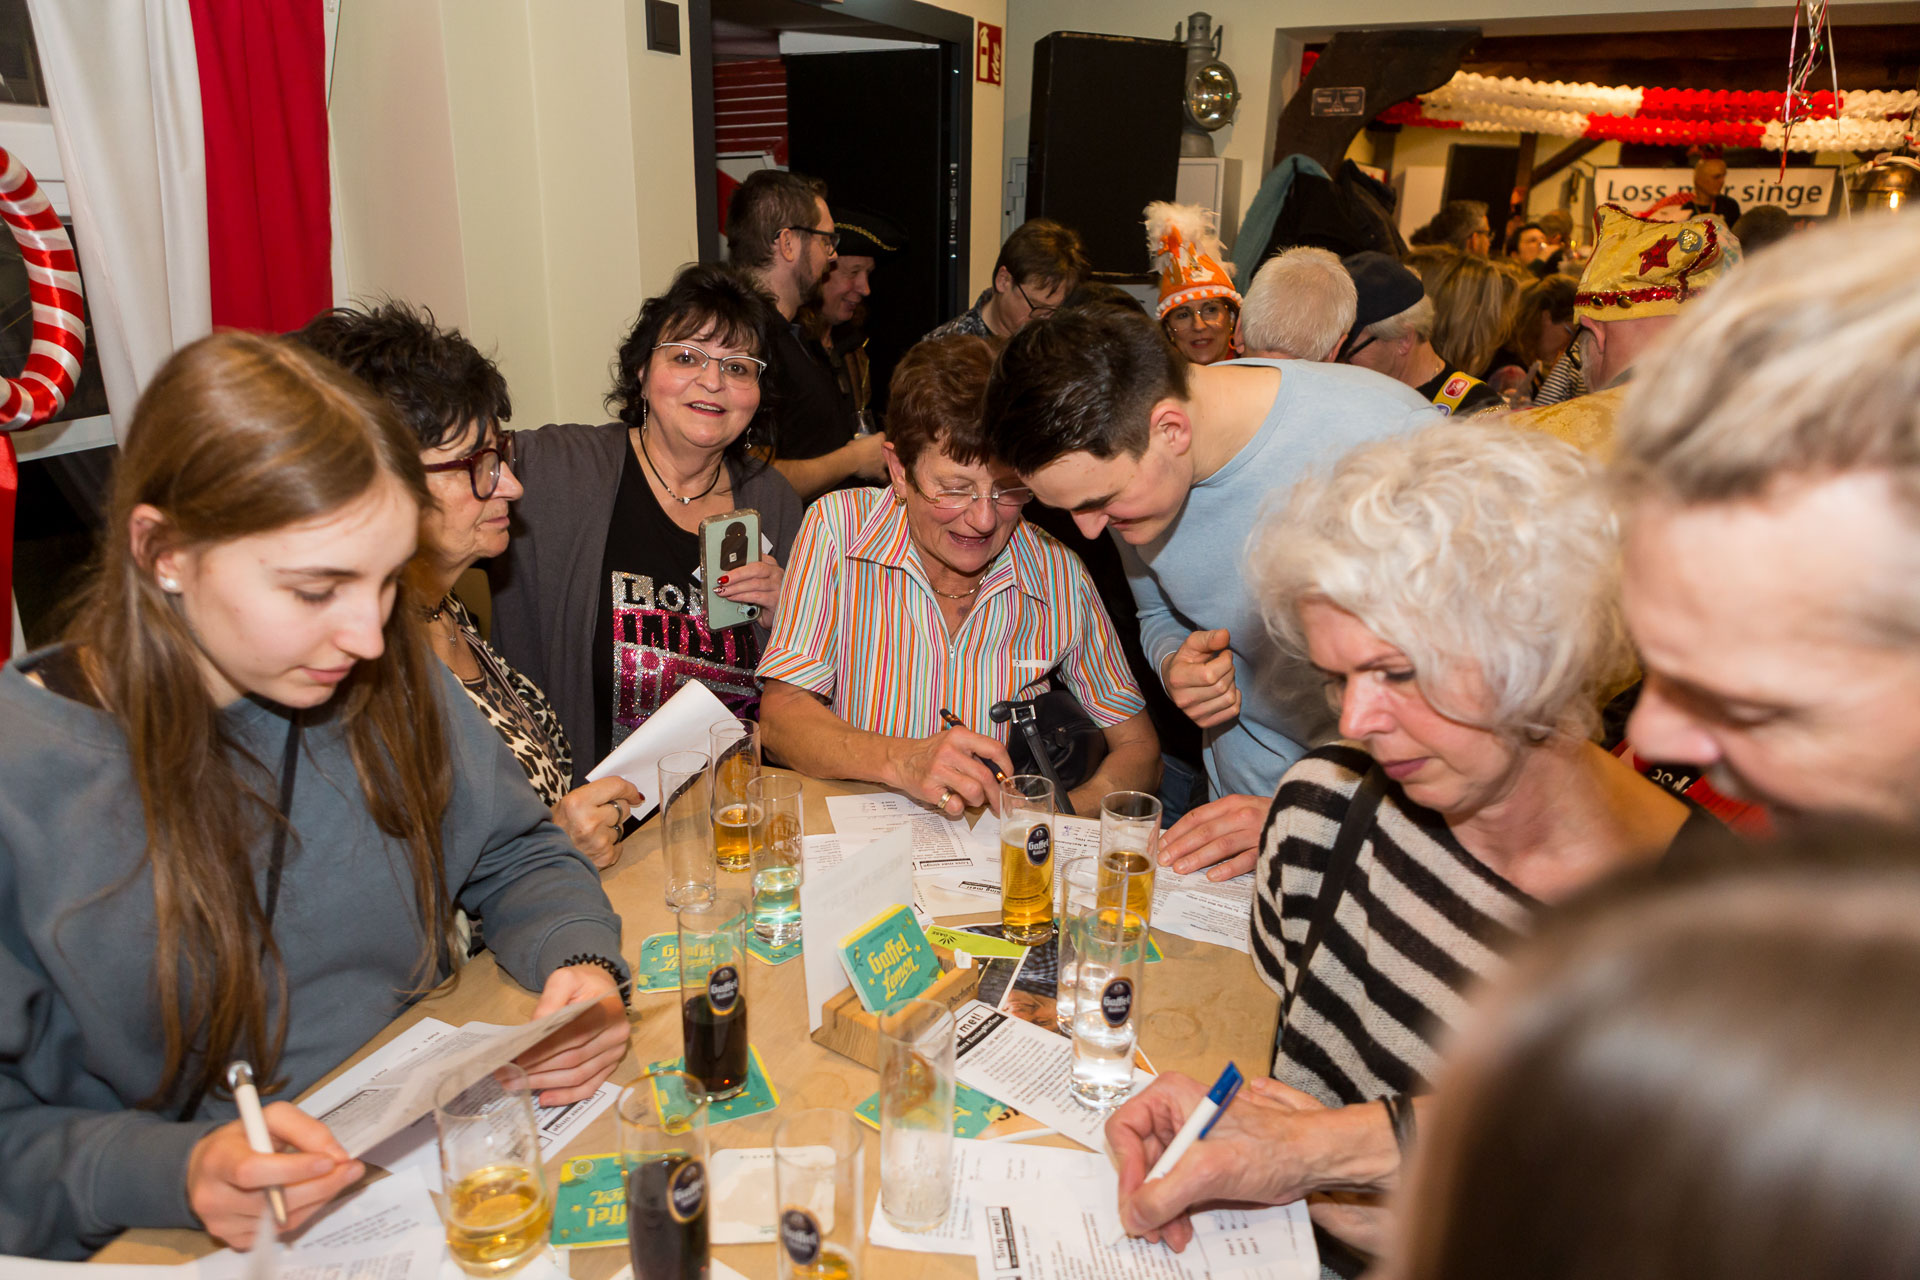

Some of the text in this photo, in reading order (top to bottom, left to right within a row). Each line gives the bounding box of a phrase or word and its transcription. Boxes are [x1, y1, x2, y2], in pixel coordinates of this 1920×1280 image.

[1607, 179, 1823, 208] Loss mr singe
[867, 932, 912, 975] Gaffel
[881, 955, 920, 1001] Lemon
